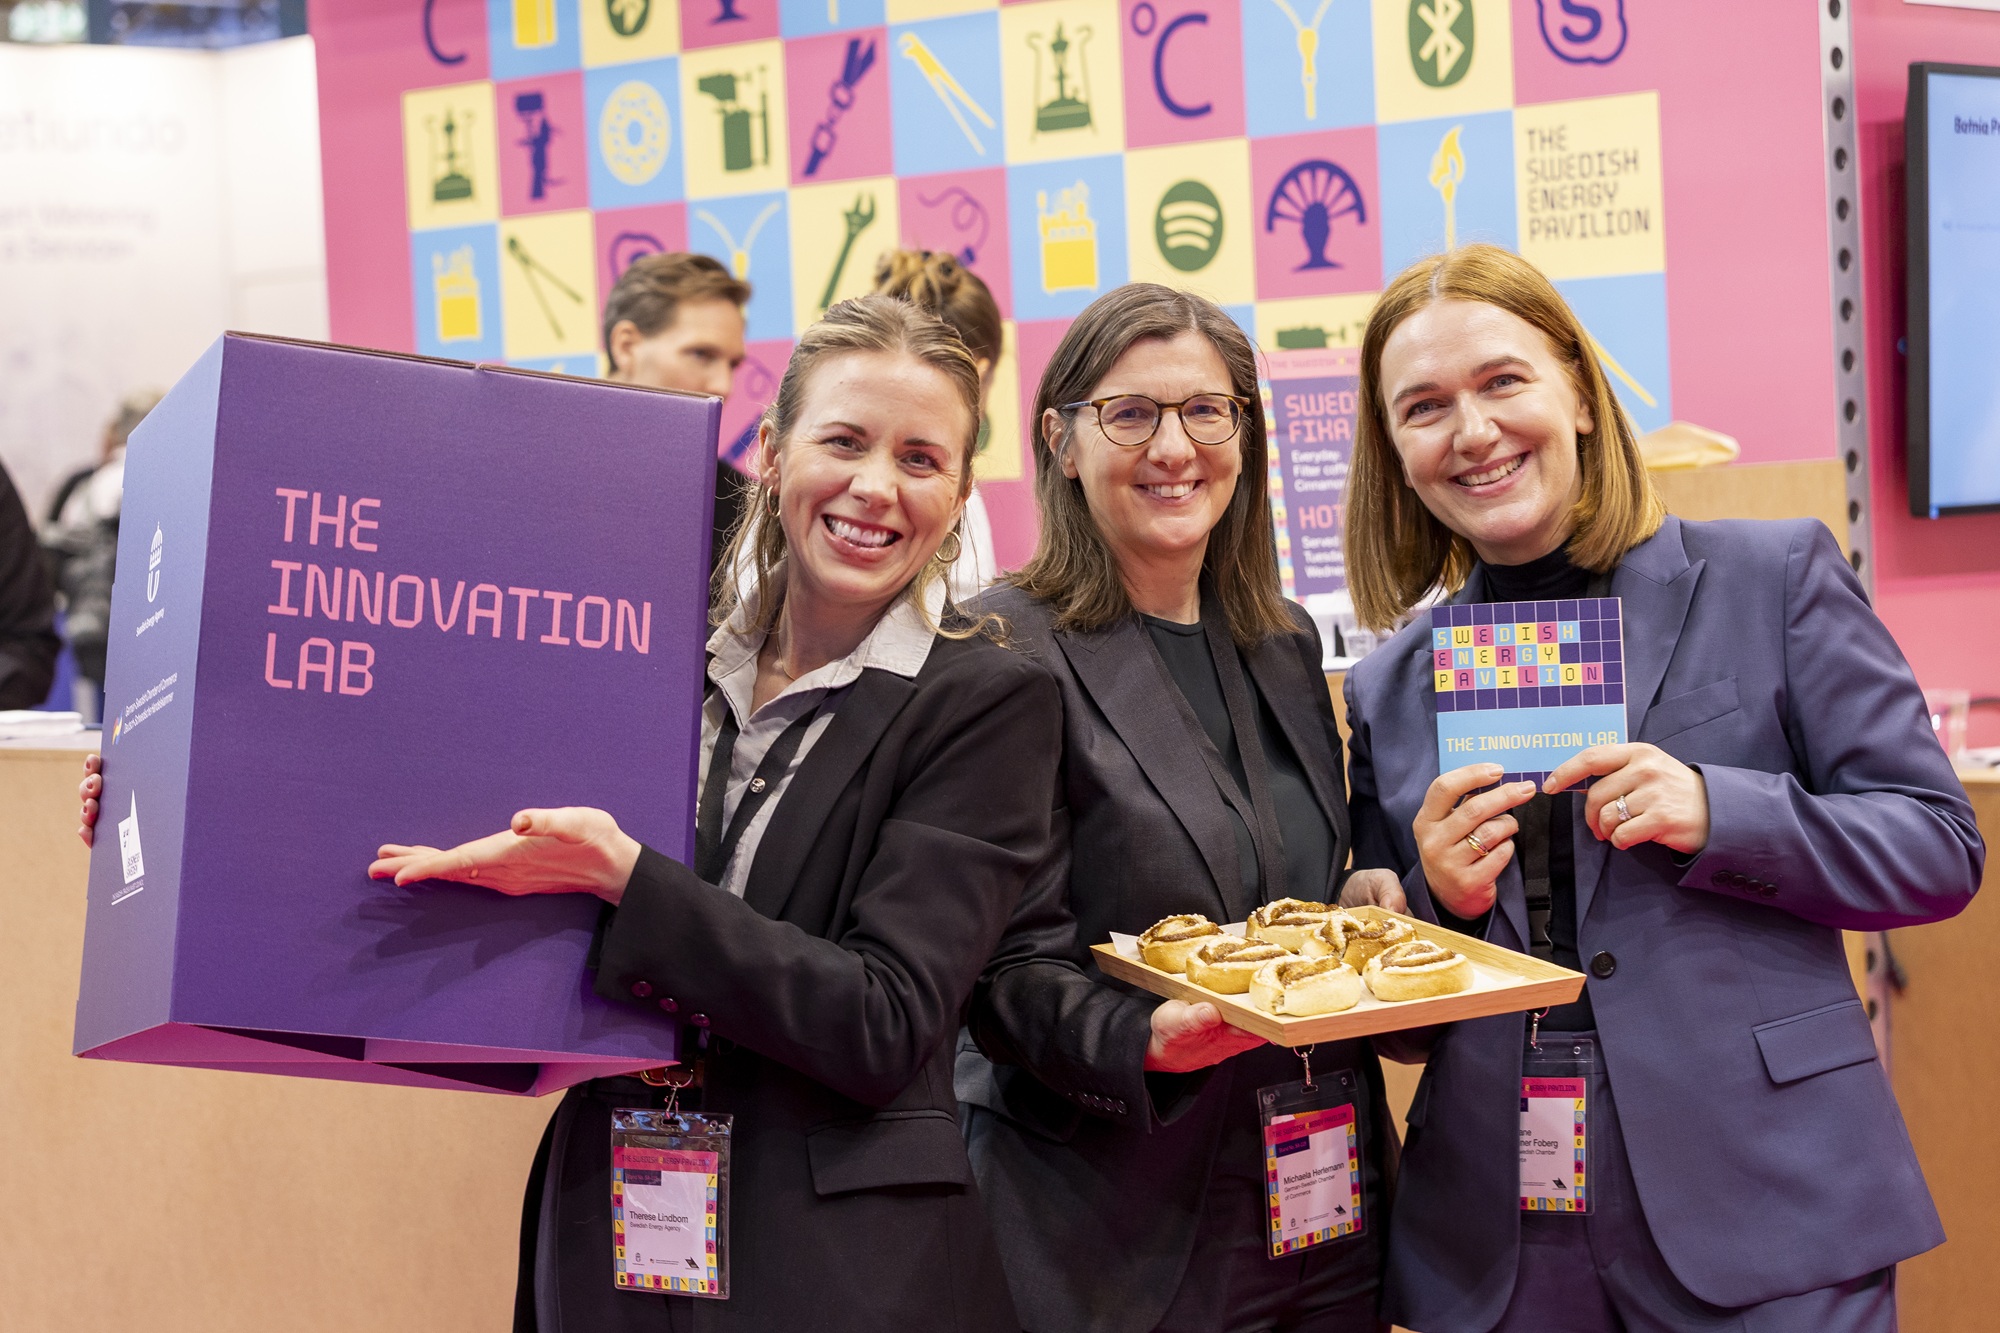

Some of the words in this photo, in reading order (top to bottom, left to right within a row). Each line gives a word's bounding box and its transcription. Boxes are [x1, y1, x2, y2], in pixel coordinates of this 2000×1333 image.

[1527, 125, 1567, 152] THE
[1526, 149, 1639, 184] SWEDISH
[1527, 181, 1618, 213] ENERGY
[1529, 208, 1650, 242] PAVILION
[1288, 417, 1352, 444] FIKA
[275, 487, 381, 552] THE
[267, 559, 651, 654] INNOVATION
[1438, 624, 1573, 646] SWEDISH
[265, 632, 375, 696] LAB
[1438, 647, 1553, 666] ENERGY
[1440, 667, 1597, 687] PAVILION
[1446, 738, 1474, 752] THE
[1478, 732, 1583, 751] INNOVATION
[1588, 731, 1618, 746] LAB
[1533, 1139, 1558, 1149] Foberg
[1283, 1172, 1311, 1185] Michaela
[1312, 1162, 1345, 1177] Herlemann
[1284, 1180, 1317, 1193] German-Swedish
[1318, 1175, 1335, 1183] Chamber
[1290, 1190, 1311, 1199] Commerce
[629, 1210, 656, 1221] Therese
[657, 1213, 688, 1223] Lindbom
[649, 1223, 663, 1231] Energy
[664, 1224, 681, 1233] Agency
